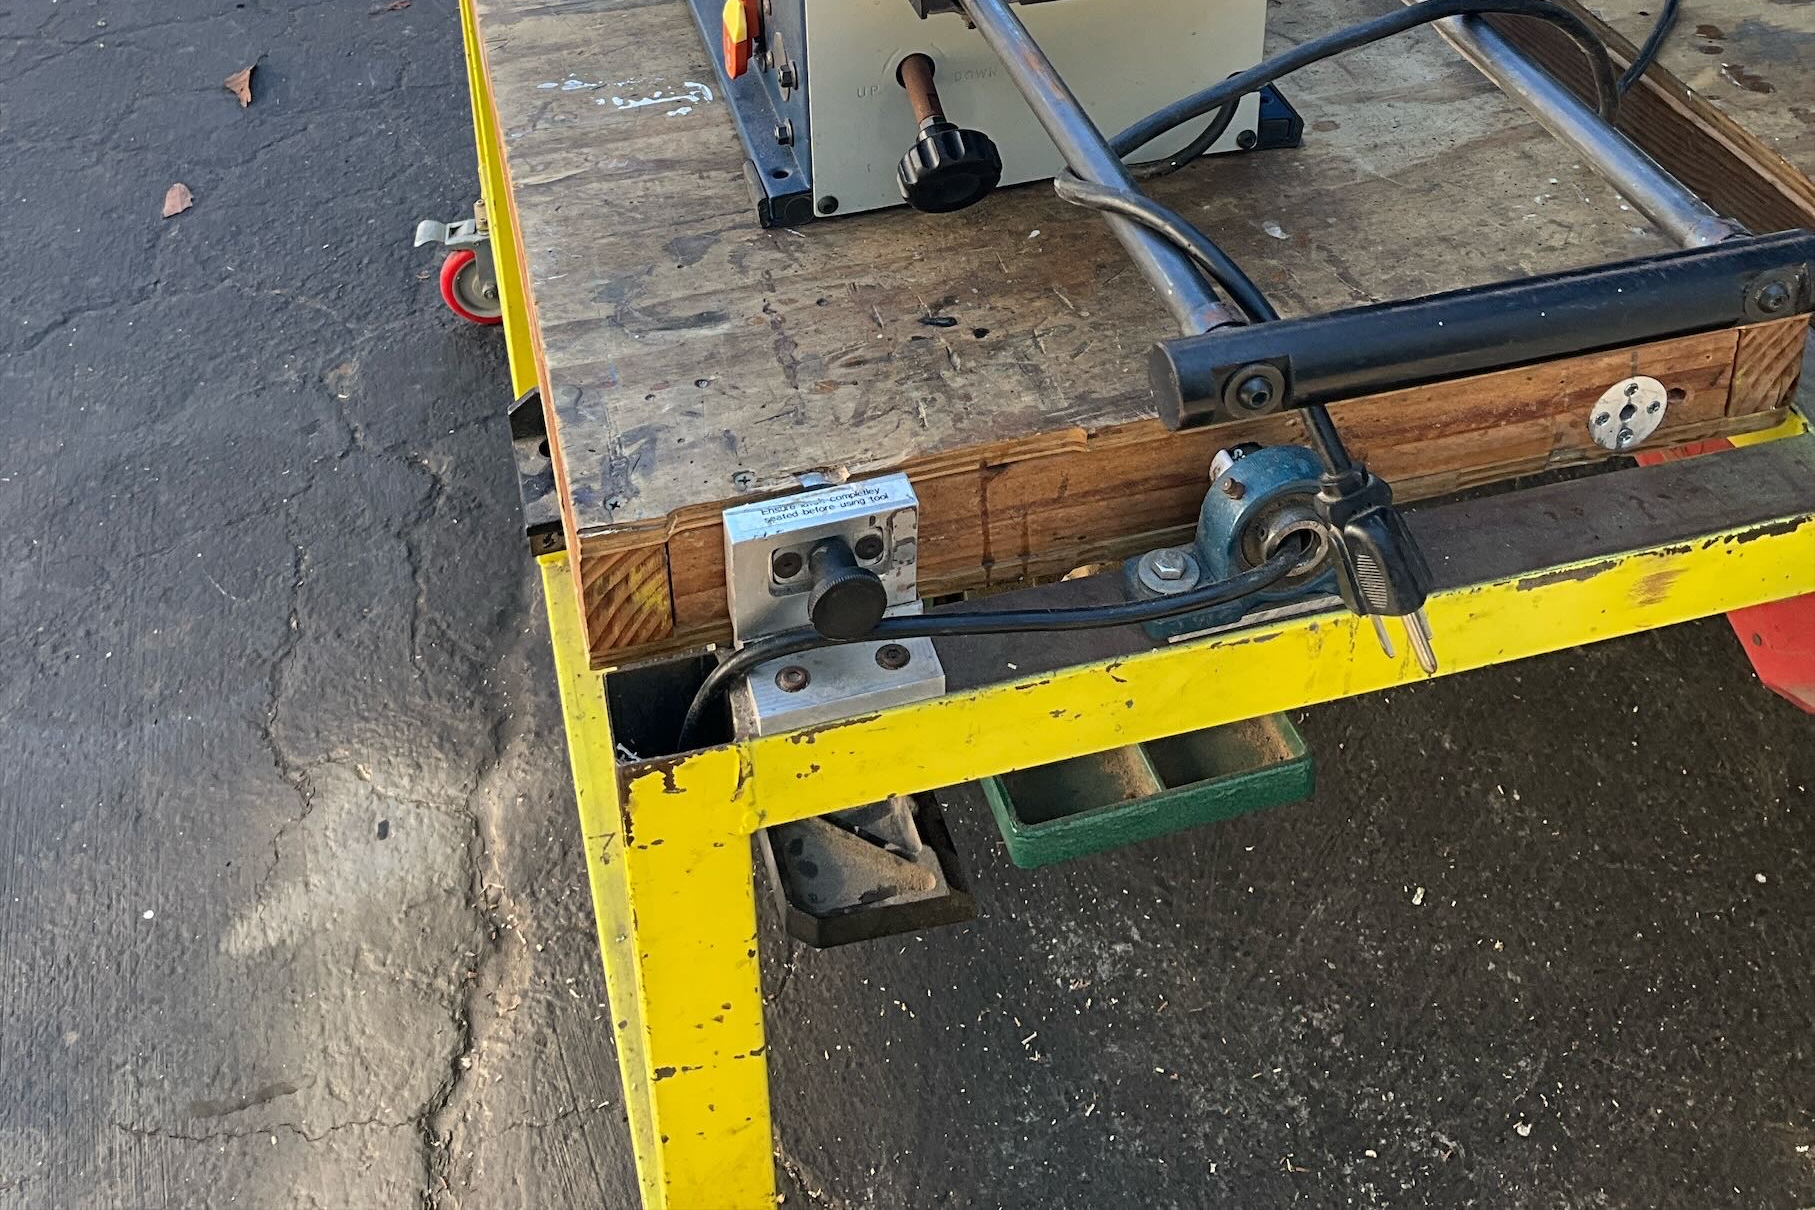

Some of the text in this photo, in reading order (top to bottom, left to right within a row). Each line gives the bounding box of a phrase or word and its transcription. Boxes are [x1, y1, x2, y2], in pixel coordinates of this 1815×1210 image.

[857, 68, 998, 98] UP DOWN
[764, 510, 799, 524] seated
[802, 504, 835, 515] before
[840, 497, 866, 508] using
[870, 493, 889, 503] tool
